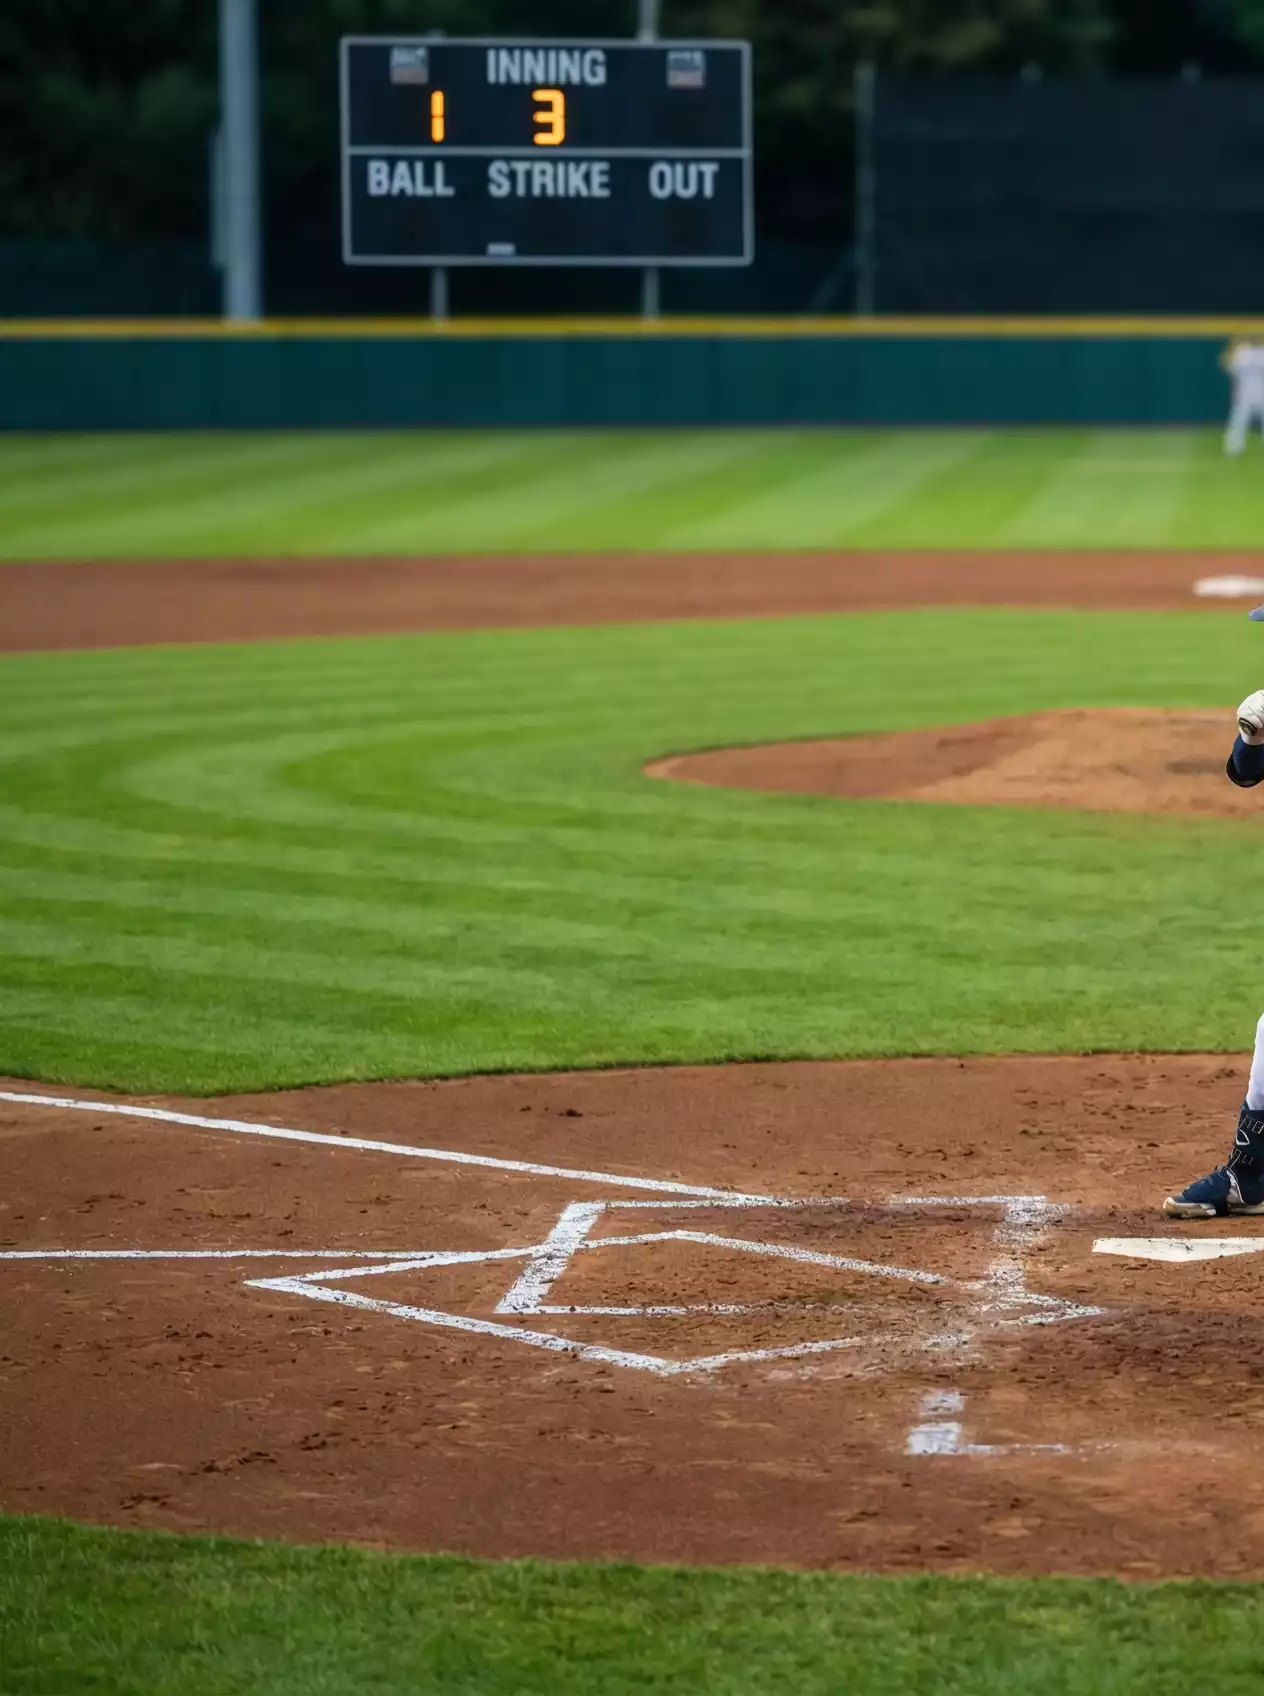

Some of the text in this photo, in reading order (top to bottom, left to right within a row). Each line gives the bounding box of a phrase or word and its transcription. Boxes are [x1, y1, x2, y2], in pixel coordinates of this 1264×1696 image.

[486, 49, 607, 86] INNING
[431, 89, 565, 145] 1 3
[367, 161, 719, 199] BALL STRIKE OUT
